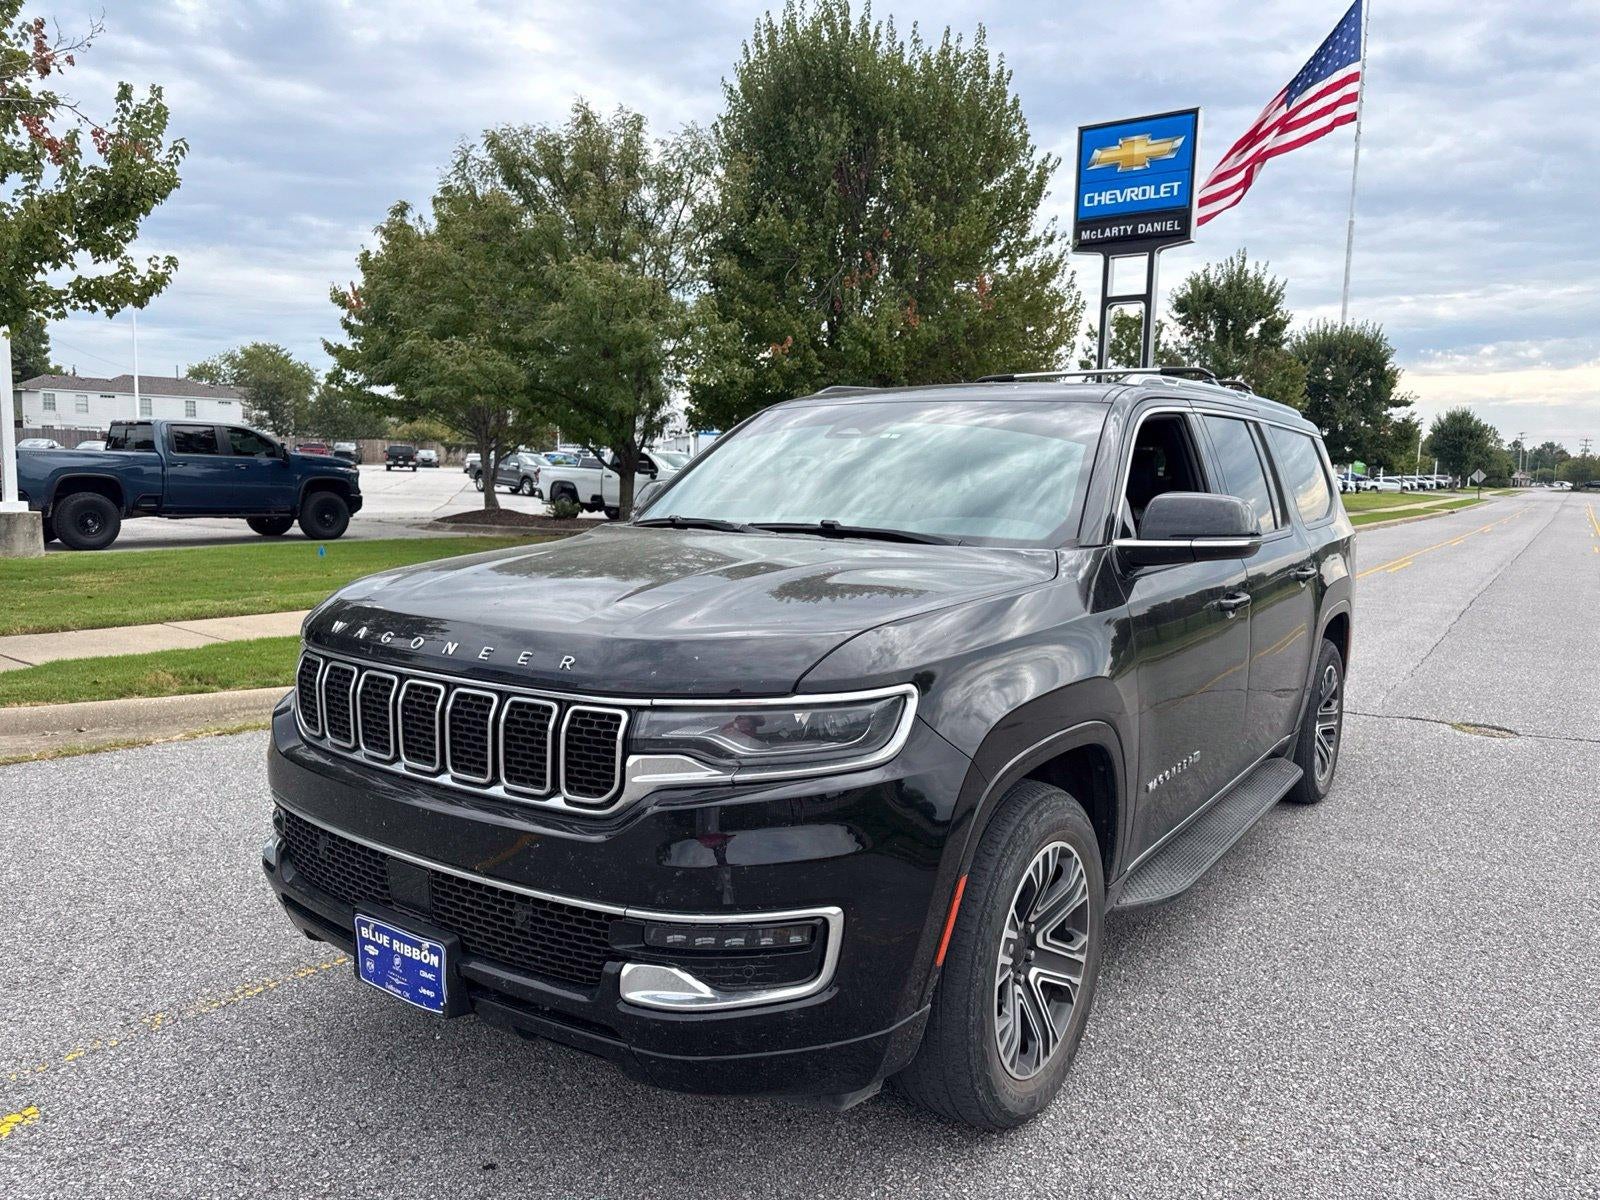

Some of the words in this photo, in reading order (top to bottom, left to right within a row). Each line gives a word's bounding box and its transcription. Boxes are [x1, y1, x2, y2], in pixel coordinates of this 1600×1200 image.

[1084, 181, 1182, 207] CHEVROLET
[1081, 224, 1134, 241] McLARTY
[1138, 220, 1181, 234] DANIEL
[331, 620, 576, 671] WAGONEER
[360, 926, 390, 948] BLUE
[392, 939, 439, 968] RIBBON
[419, 970, 436, 982] GMC
[418, 986, 435, 998] Jeep
